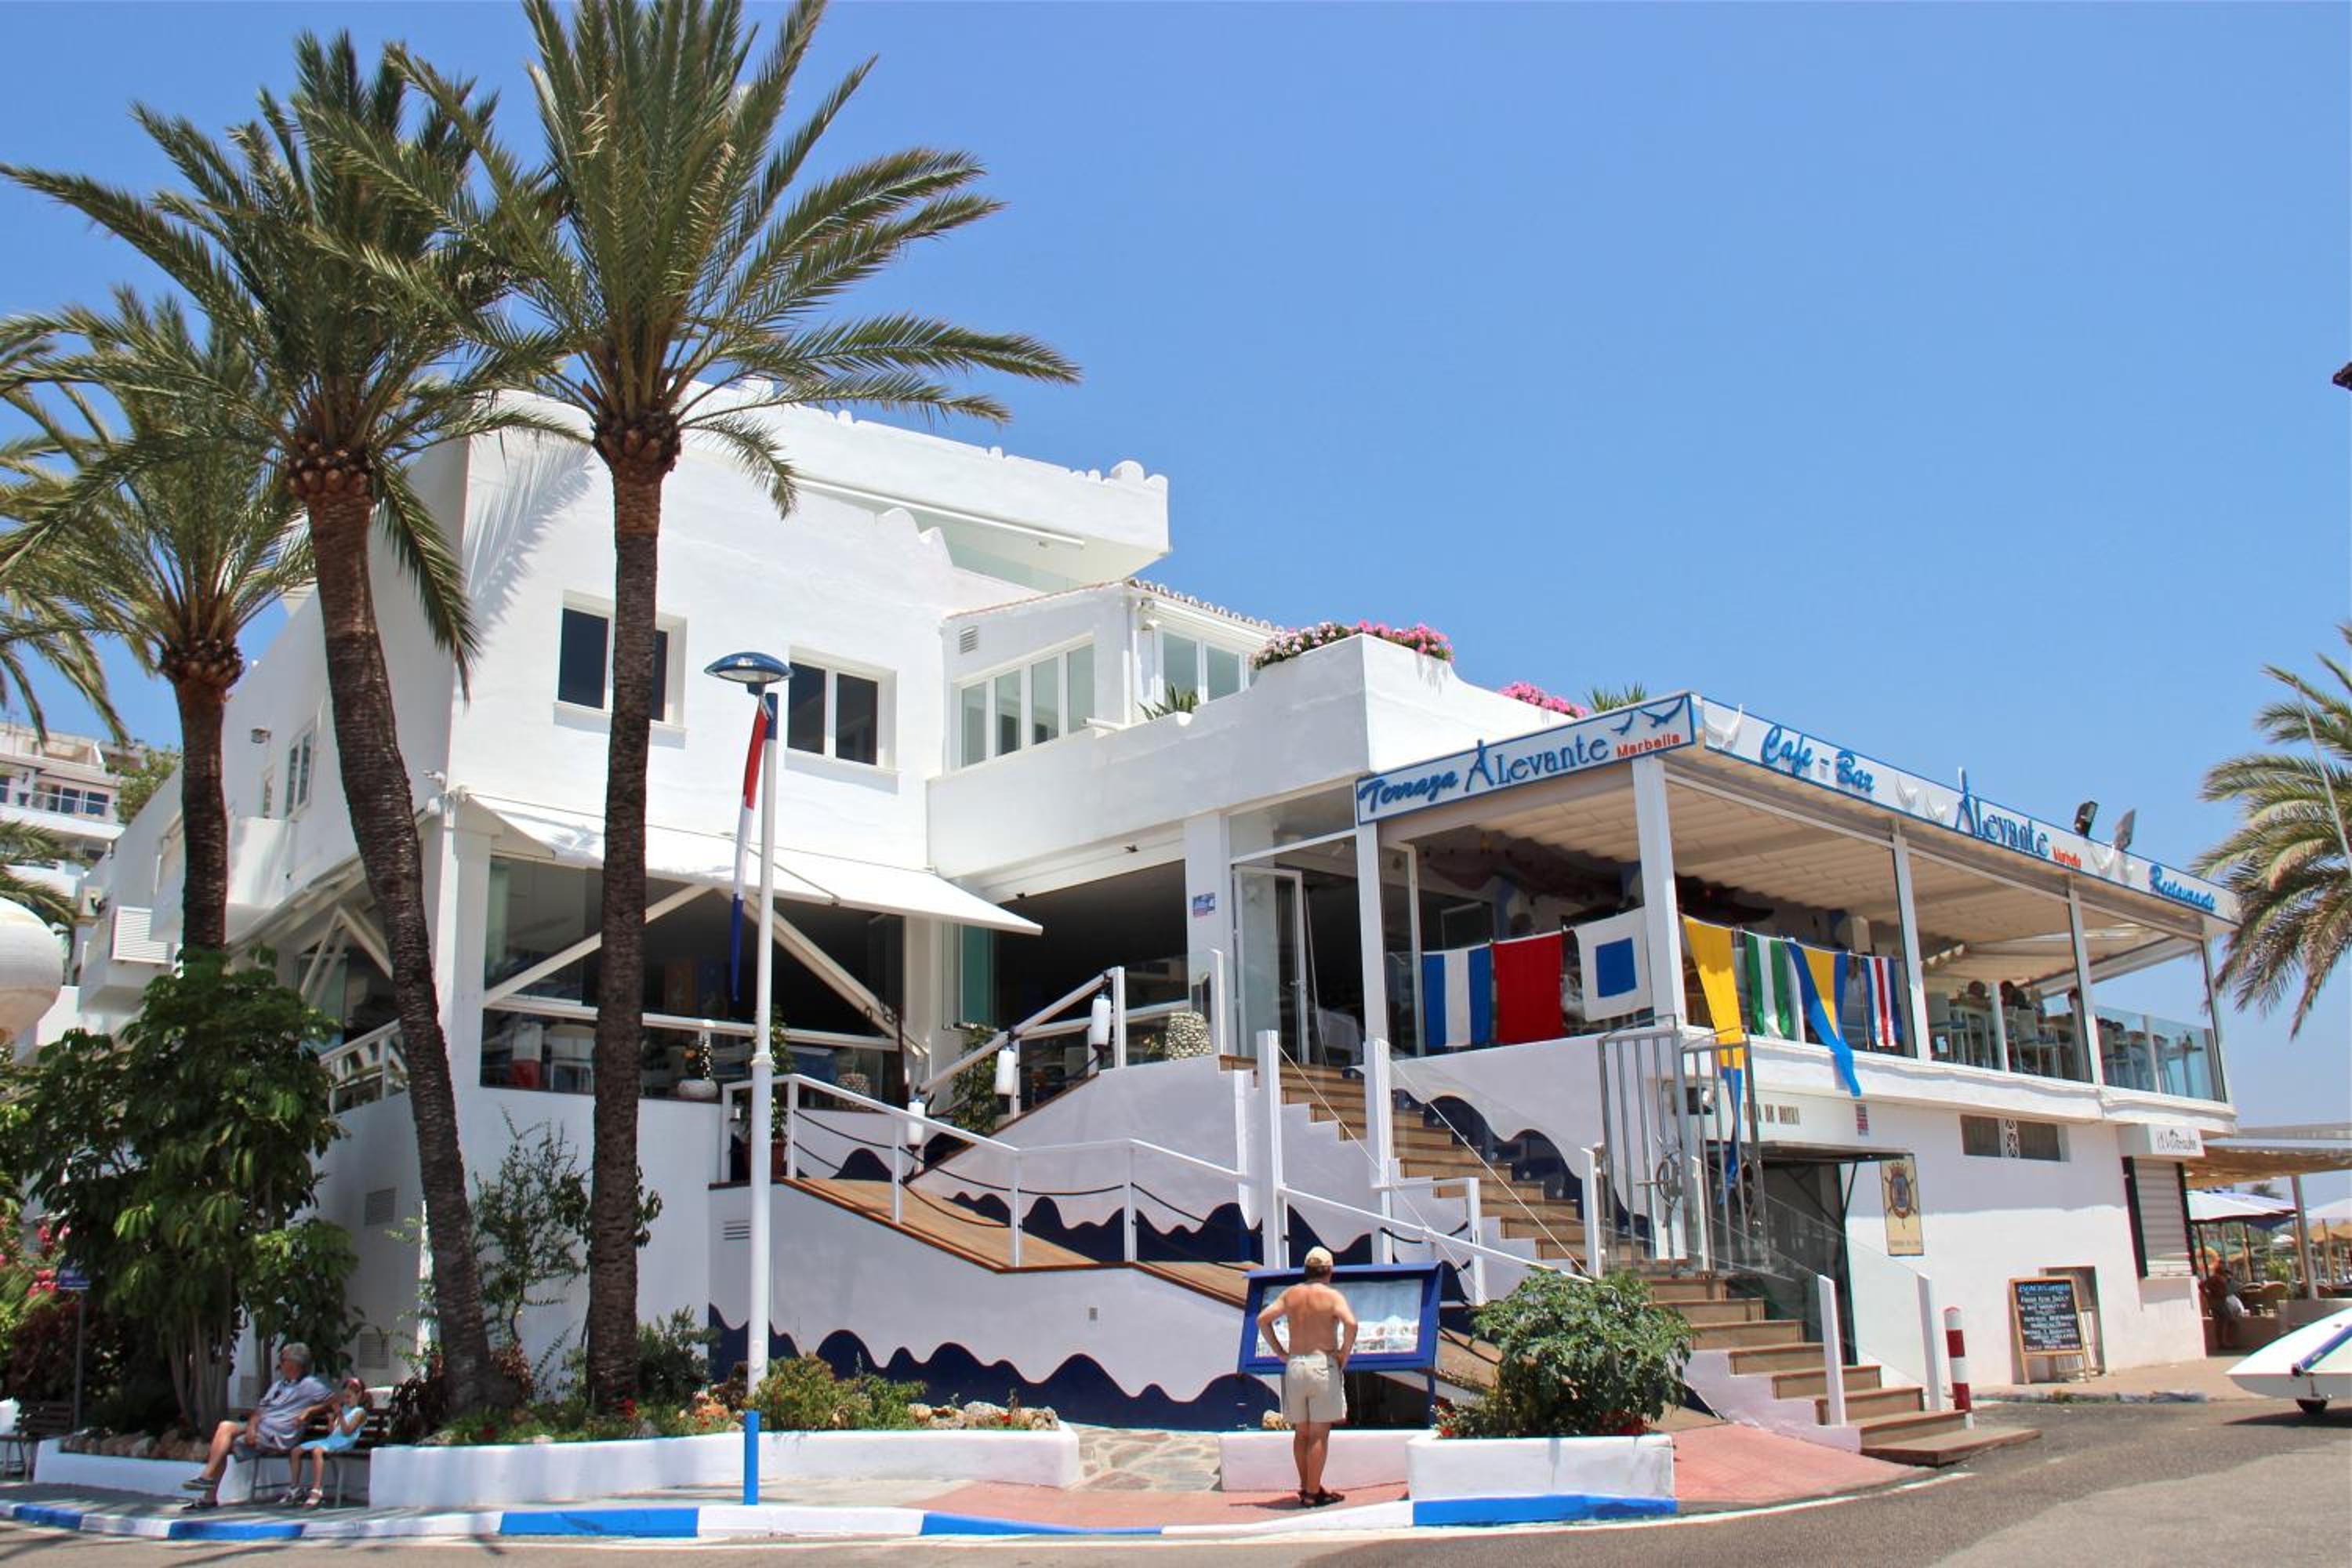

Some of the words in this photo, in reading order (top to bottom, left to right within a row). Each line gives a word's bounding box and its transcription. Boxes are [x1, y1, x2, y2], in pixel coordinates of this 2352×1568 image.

[1358, 771, 1457, 812] Terraza
[1616, 733, 1680, 757] Marbella
[1836, 749, 1875, 793] Bar
